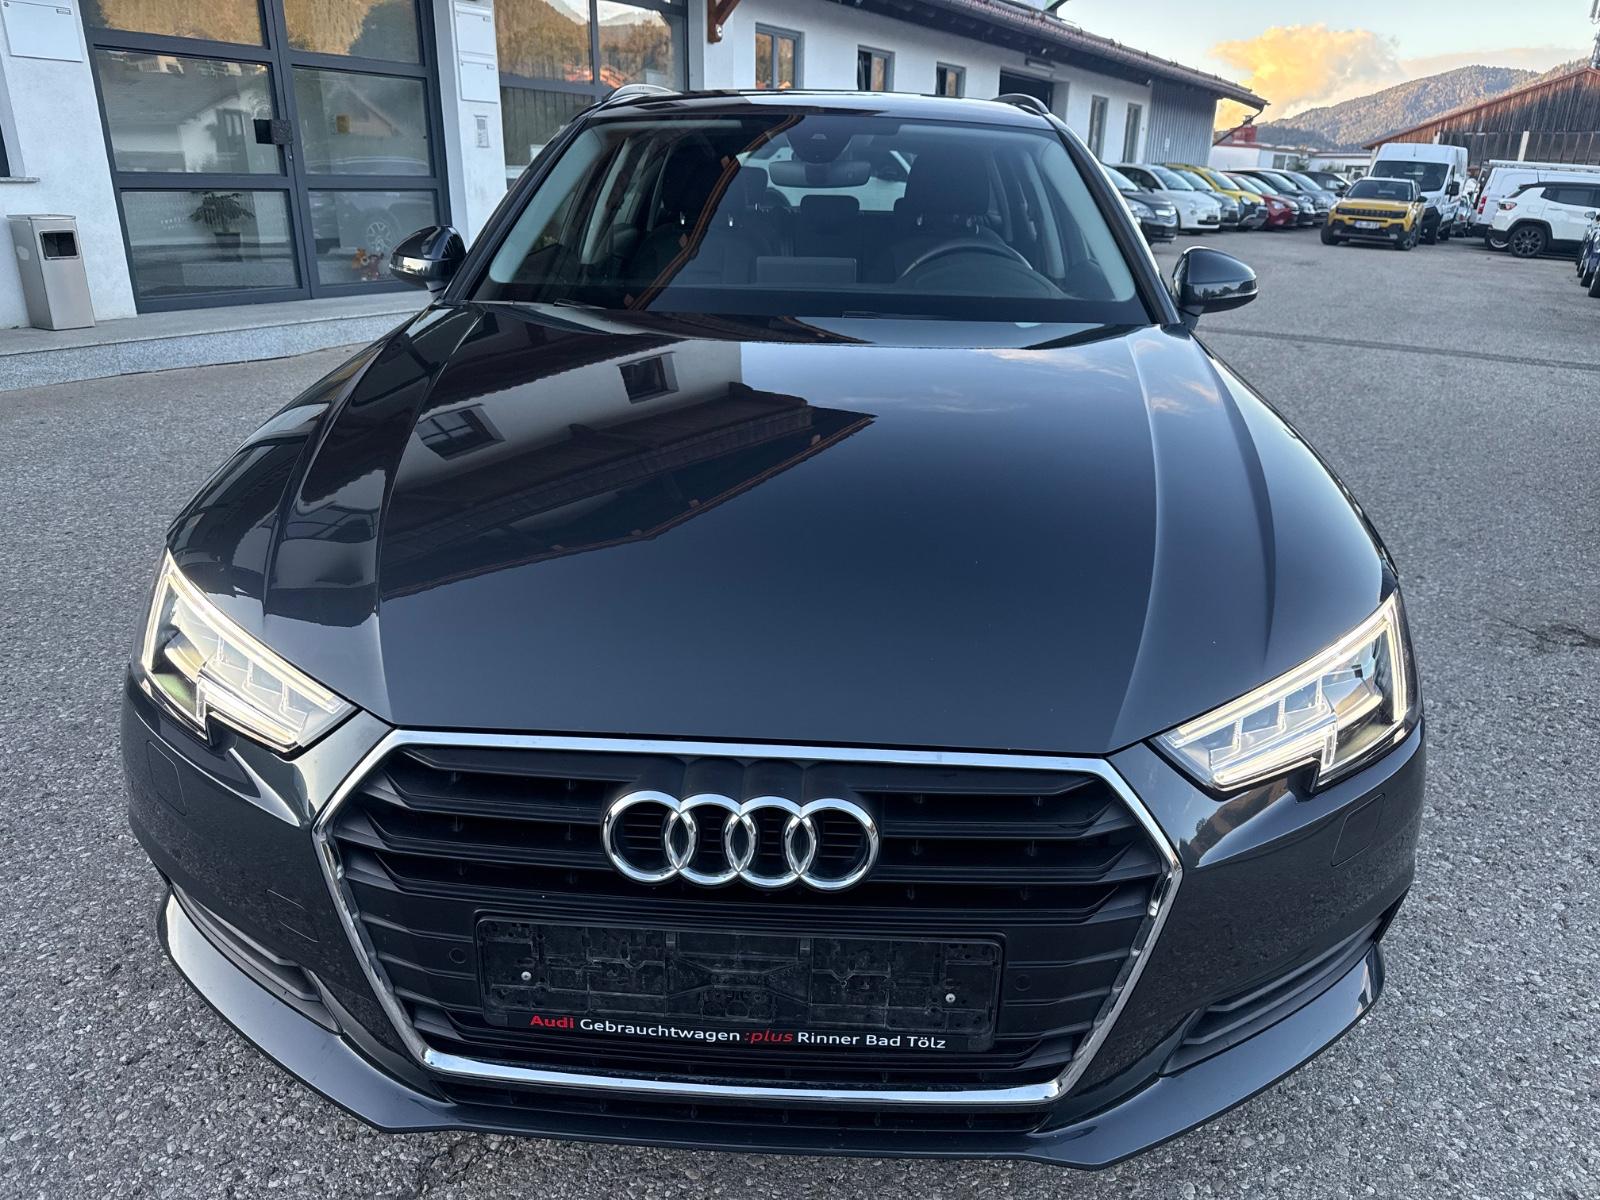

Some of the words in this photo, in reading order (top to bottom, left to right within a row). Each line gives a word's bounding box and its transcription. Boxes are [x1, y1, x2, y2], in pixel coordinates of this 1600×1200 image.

[530, 1015, 574, 1029] Audi
[580, 1018, 740, 1042] Gebrauchtwagen
[798, 1031, 860, 1045] Rinner
[865, 1034, 901, 1047] Bad
[907, 1036, 946, 1049] Tölz
